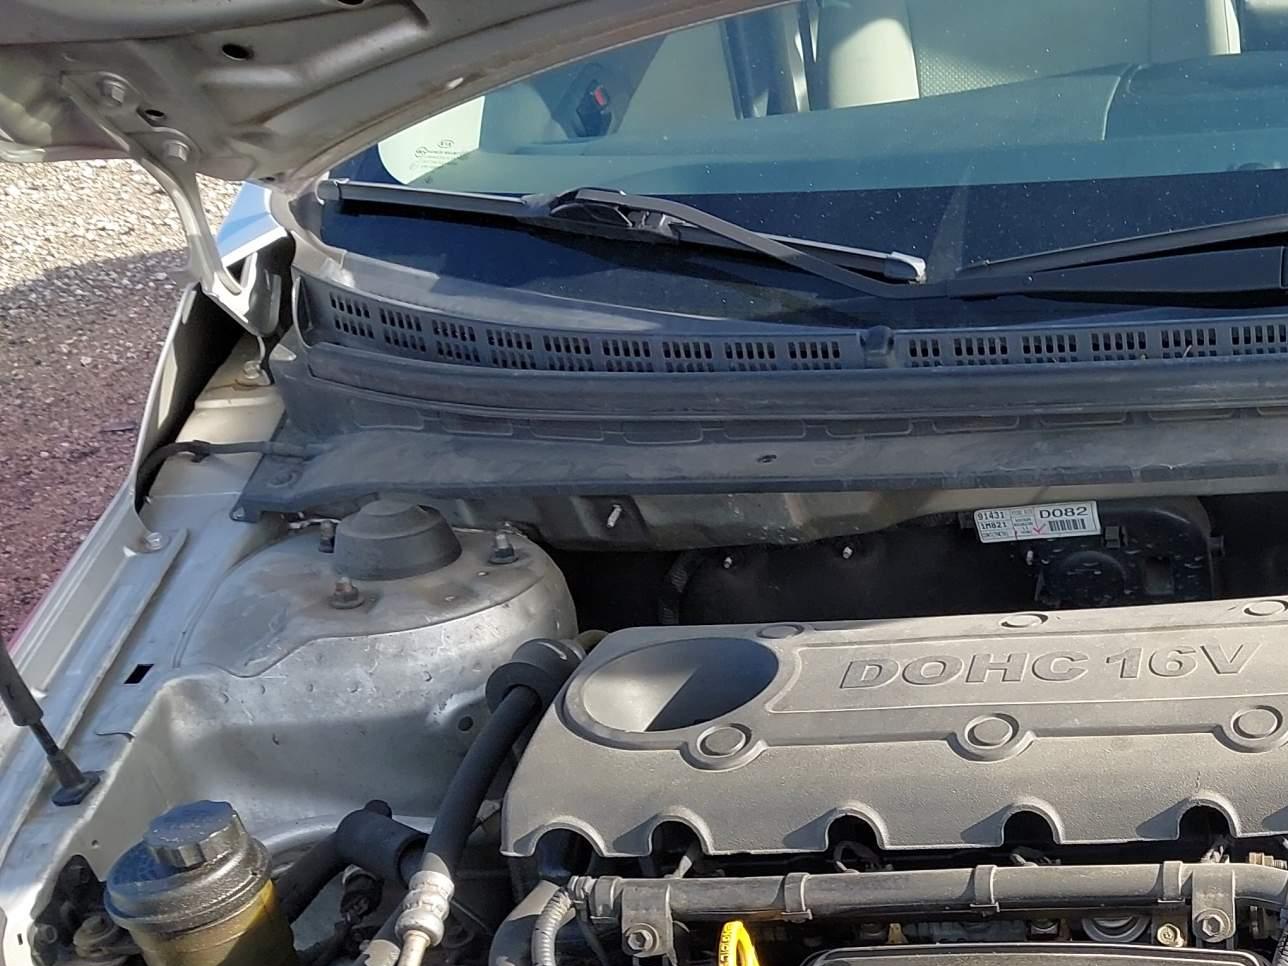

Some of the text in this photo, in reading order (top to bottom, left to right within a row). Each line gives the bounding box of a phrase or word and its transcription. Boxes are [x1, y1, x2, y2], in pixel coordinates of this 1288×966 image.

[977, 511, 1005, 520] 91431
[1039, 506, 1088, 519] D082
[839, 641, 1264, 690] DOHC 16V
